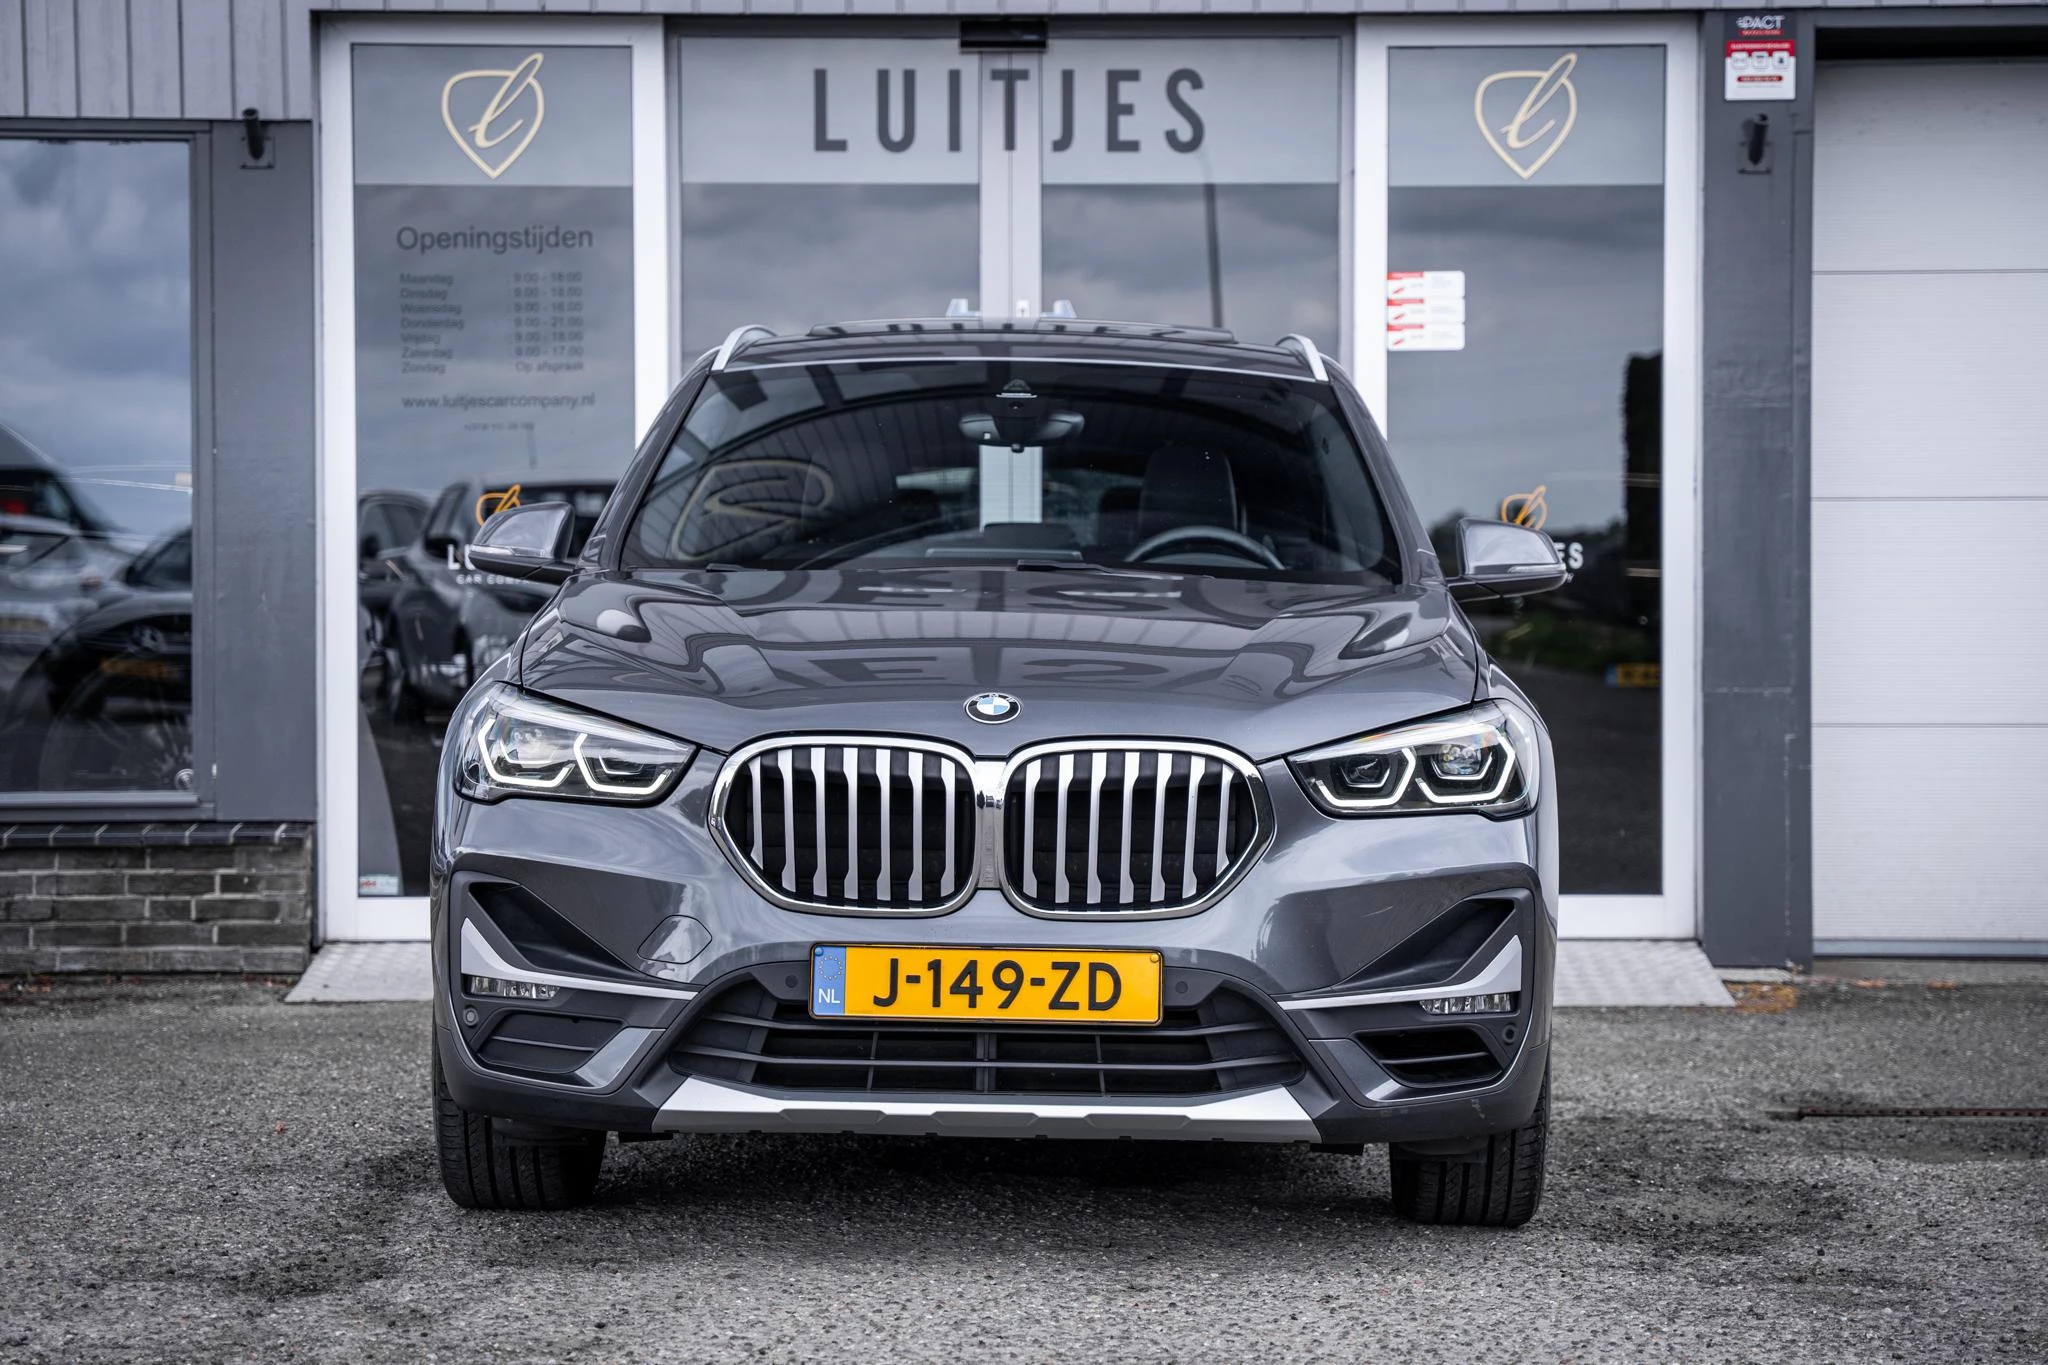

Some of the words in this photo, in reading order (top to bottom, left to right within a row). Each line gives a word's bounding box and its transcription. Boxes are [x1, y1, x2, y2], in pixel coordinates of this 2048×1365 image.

[814, 68, 1205, 153] LUITJES
[396, 226, 593, 254] Openingstijden
[401, 392, 596, 411] www.luitjescarcompany.nl
[818, 988, 841, 1004] NL
[873, 958, 1122, 1011] J-149-ZD
